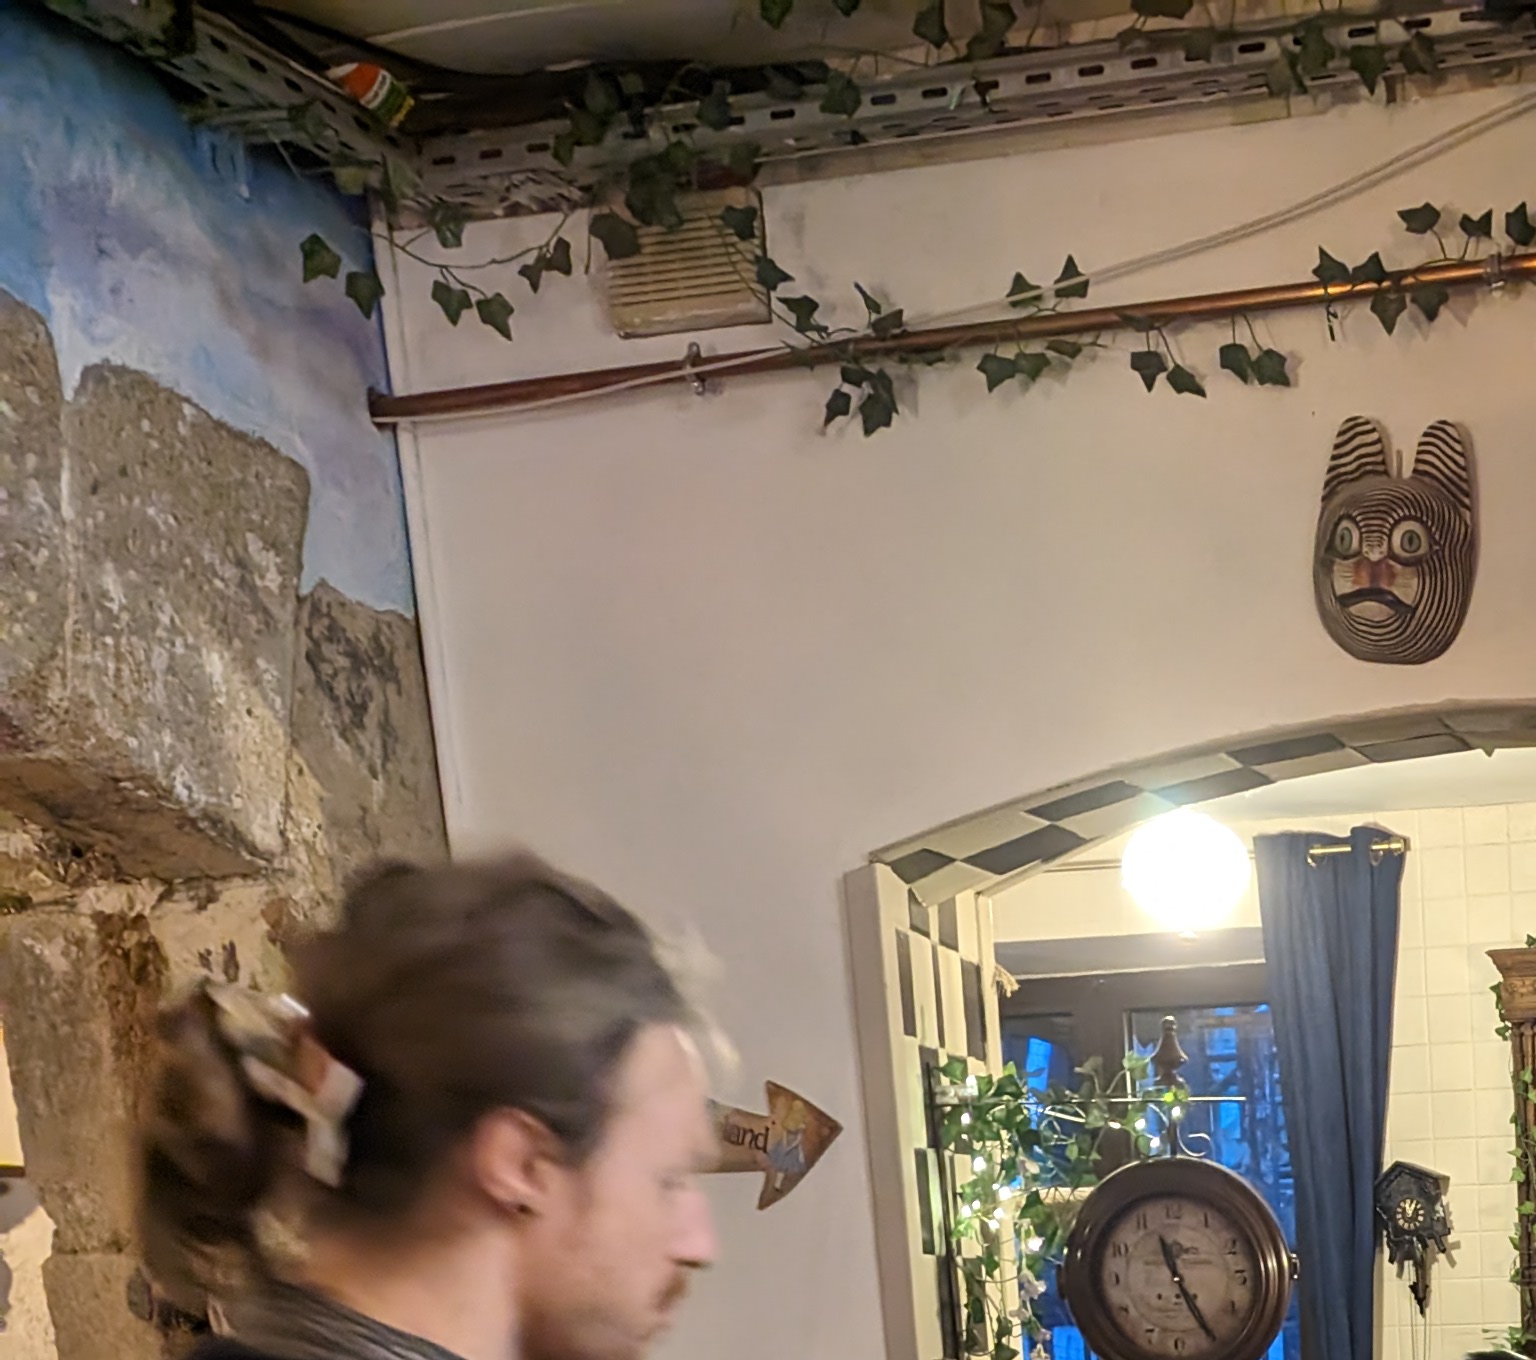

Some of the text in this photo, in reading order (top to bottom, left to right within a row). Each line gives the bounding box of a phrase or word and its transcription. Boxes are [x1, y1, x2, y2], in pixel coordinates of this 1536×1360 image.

[1165, 1203, 1182, 1220] 12
[1136, 1213, 1148, 1231] 11
[1112, 1241, 1129, 1259] 10
